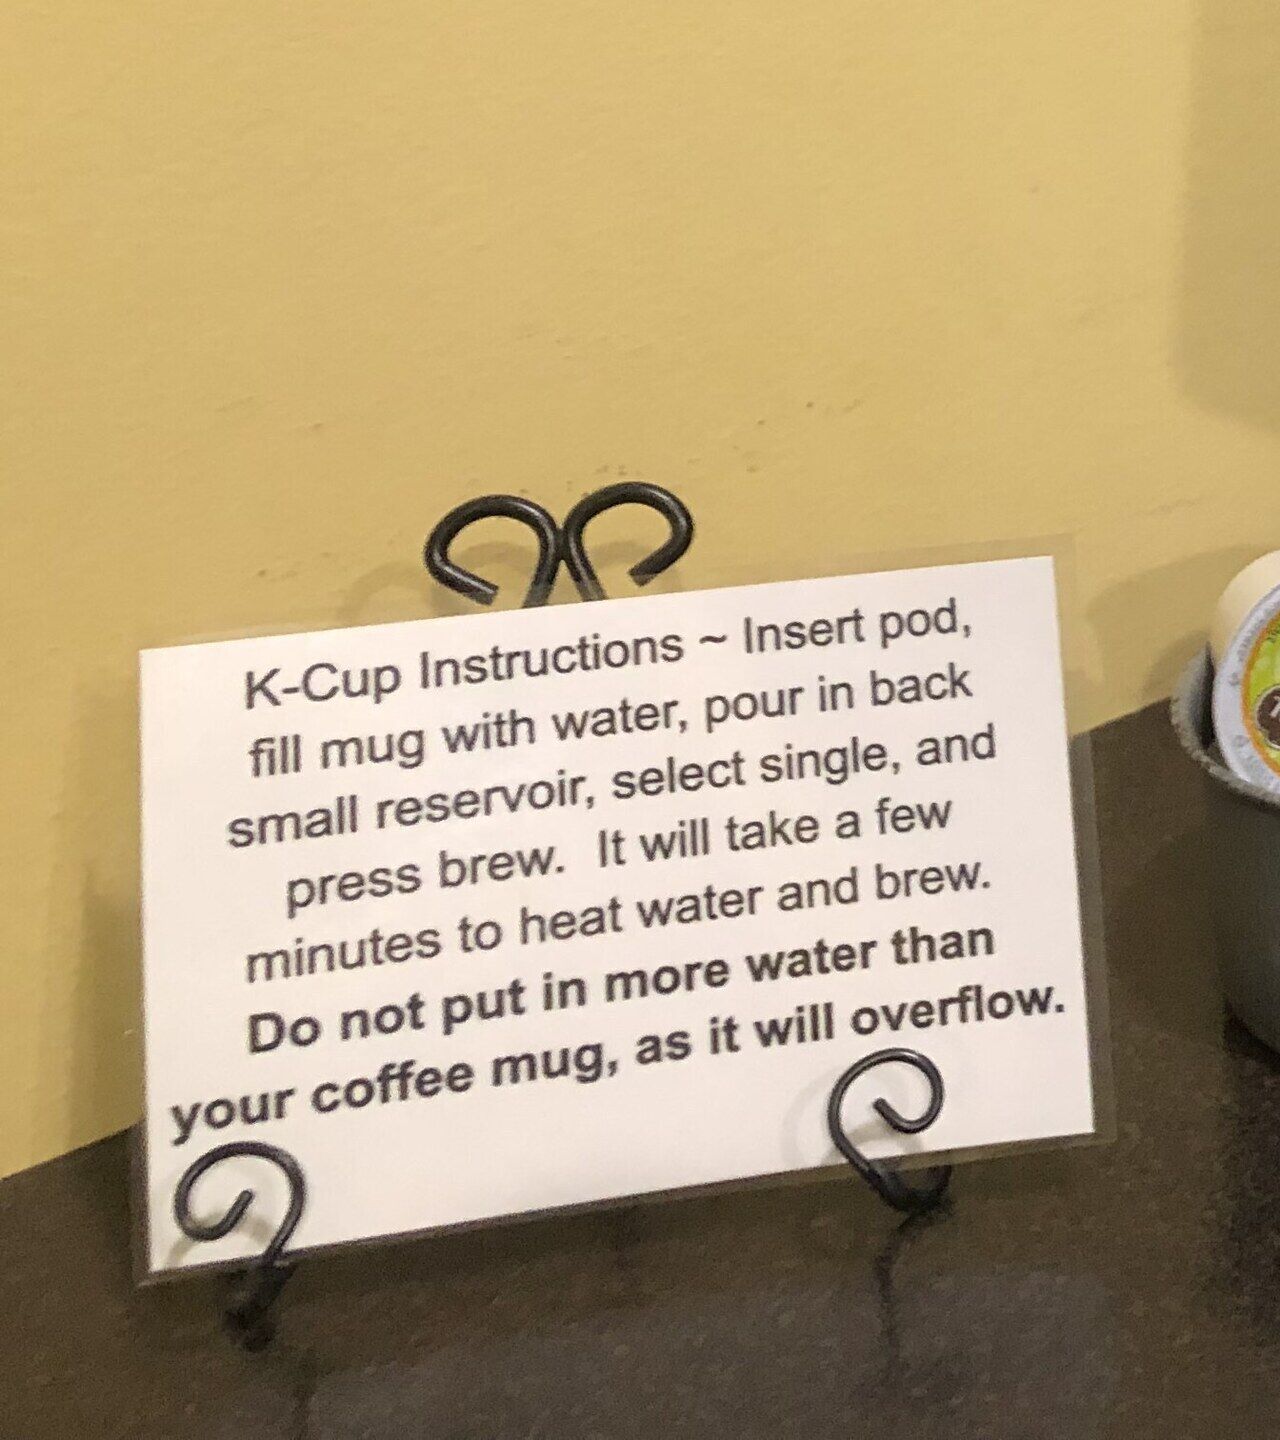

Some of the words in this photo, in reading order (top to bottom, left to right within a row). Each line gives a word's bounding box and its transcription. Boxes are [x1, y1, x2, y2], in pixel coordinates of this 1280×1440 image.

[246, 662, 402, 710] K-Cup
[421, 632, 684, 689] Instructions
[744, 608, 865, 654] Insert
[879, 597, 971, 650] pod,
[248, 733, 302, 777] fill
[321, 729, 425, 770] mug
[441, 709, 536, 754] with
[551, 698, 687, 741] water,
[705, 686, 805, 734] pour
[817, 675, 854, 712] in
[869, 662, 974, 707] back
[228, 794, 358, 848] small
[377, 769, 595, 829] reservoir,
[612, 751, 746, 800] select
[759, 736, 900, 786] single,
[917, 722, 996, 766] and
[287, 863, 422, 920] press
[438, 846, 565, 888] brew.
[599, 829, 626, 868] It
[639, 817, 710, 862] will
[725, 810, 820, 852] take
[835, 810, 861, 840] a
[874, 796, 952, 835] few
[247, 928, 442, 984] minutes
[457, 916, 503, 953] to
[520, 897, 623, 945] heat
[636, 884, 765, 929] water
[777, 866, 859, 912] and
[875, 861, 991, 900] brew.
[248, 1012, 321, 1054] Do
[340, 992, 425, 1041] not
[441, 978, 526, 1036] put
[542, 971, 587, 1011] in
[605, 959, 730, 1003] more
[744, 938, 878, 983] water
[890, 926, 994, 966] than
[170, 1088, 296, 1155] your
[311, 1059, 475, 1114] coffee
[492, 1042, 618, 1087] mug,
[635, 1030, 692, 1066] as
[710, 1016, 741, 1055] it
[752, 1001, 834, 1048] will
[850, 984, 1065, 1036] overflow.
